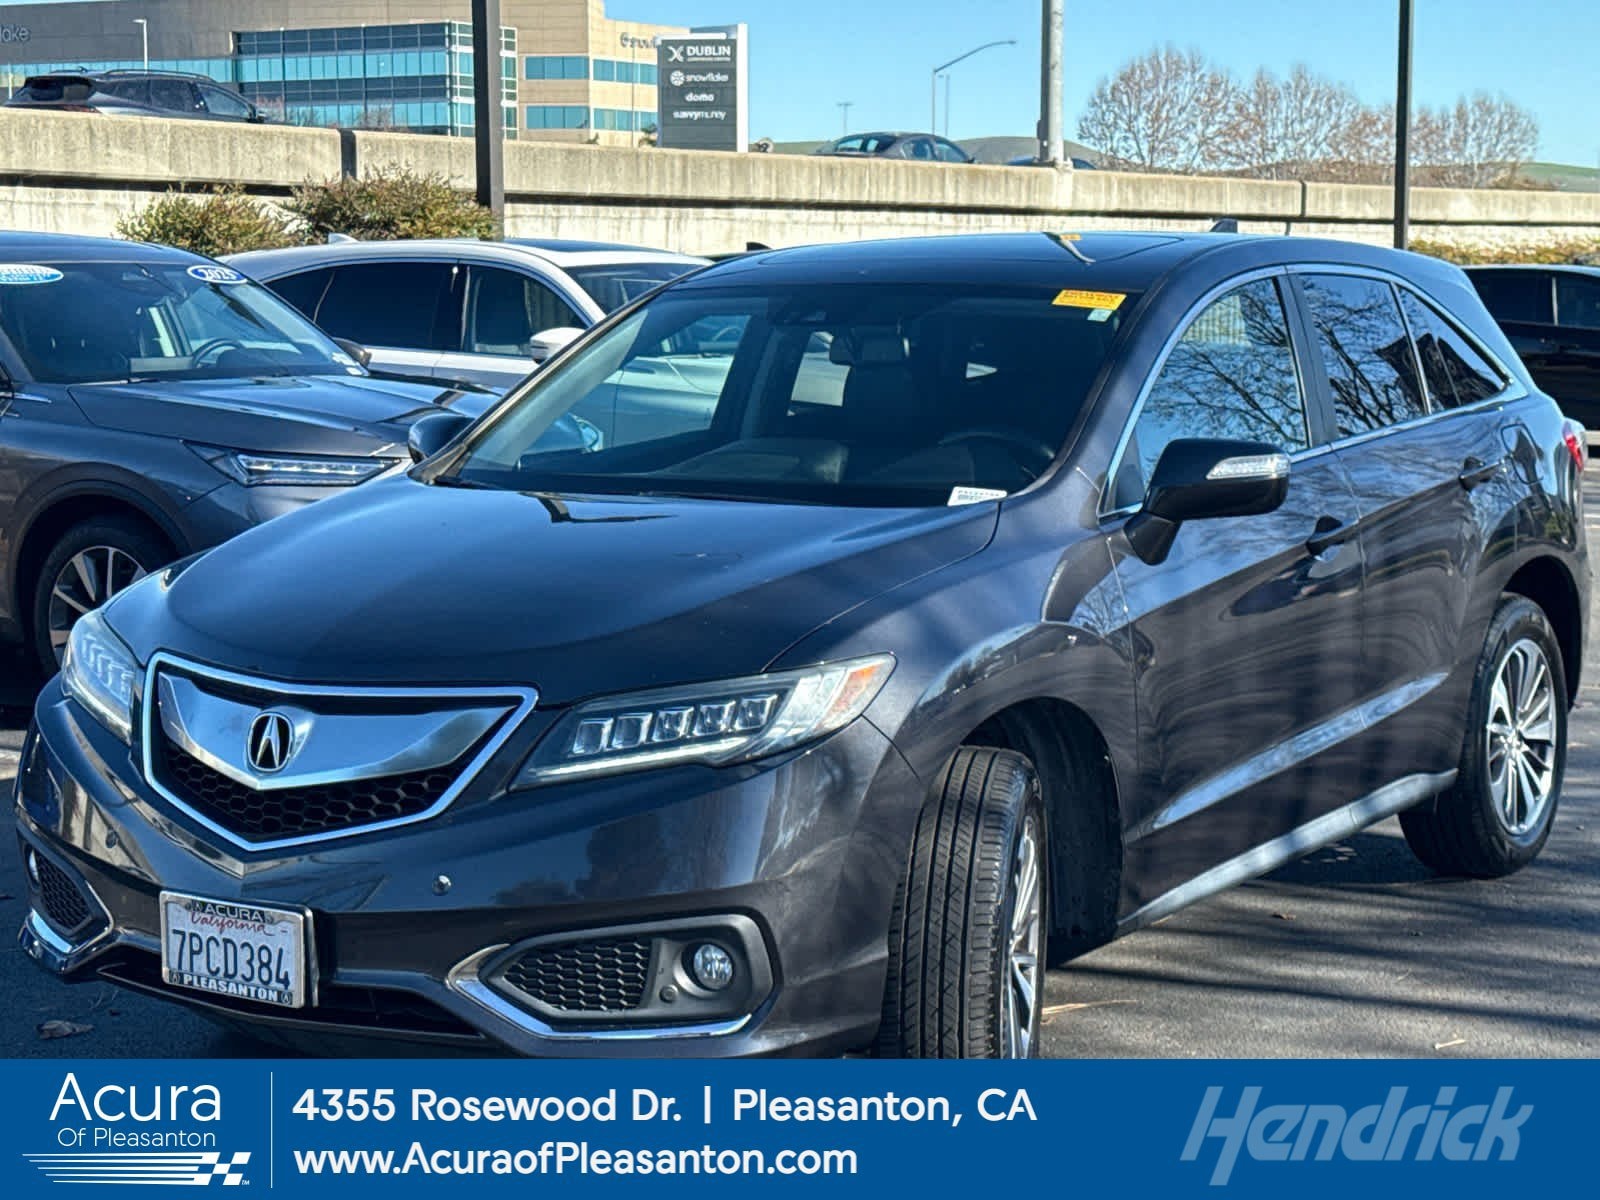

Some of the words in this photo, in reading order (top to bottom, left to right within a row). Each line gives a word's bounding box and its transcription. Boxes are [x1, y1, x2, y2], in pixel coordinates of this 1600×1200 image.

[687, 45, 731, 56] DUBLIN
[204, 904, 263, 921] ACURA
[172, 929, 290, 990] 7PCD384
[183, 974, 278, 1002] PLEASANTON
